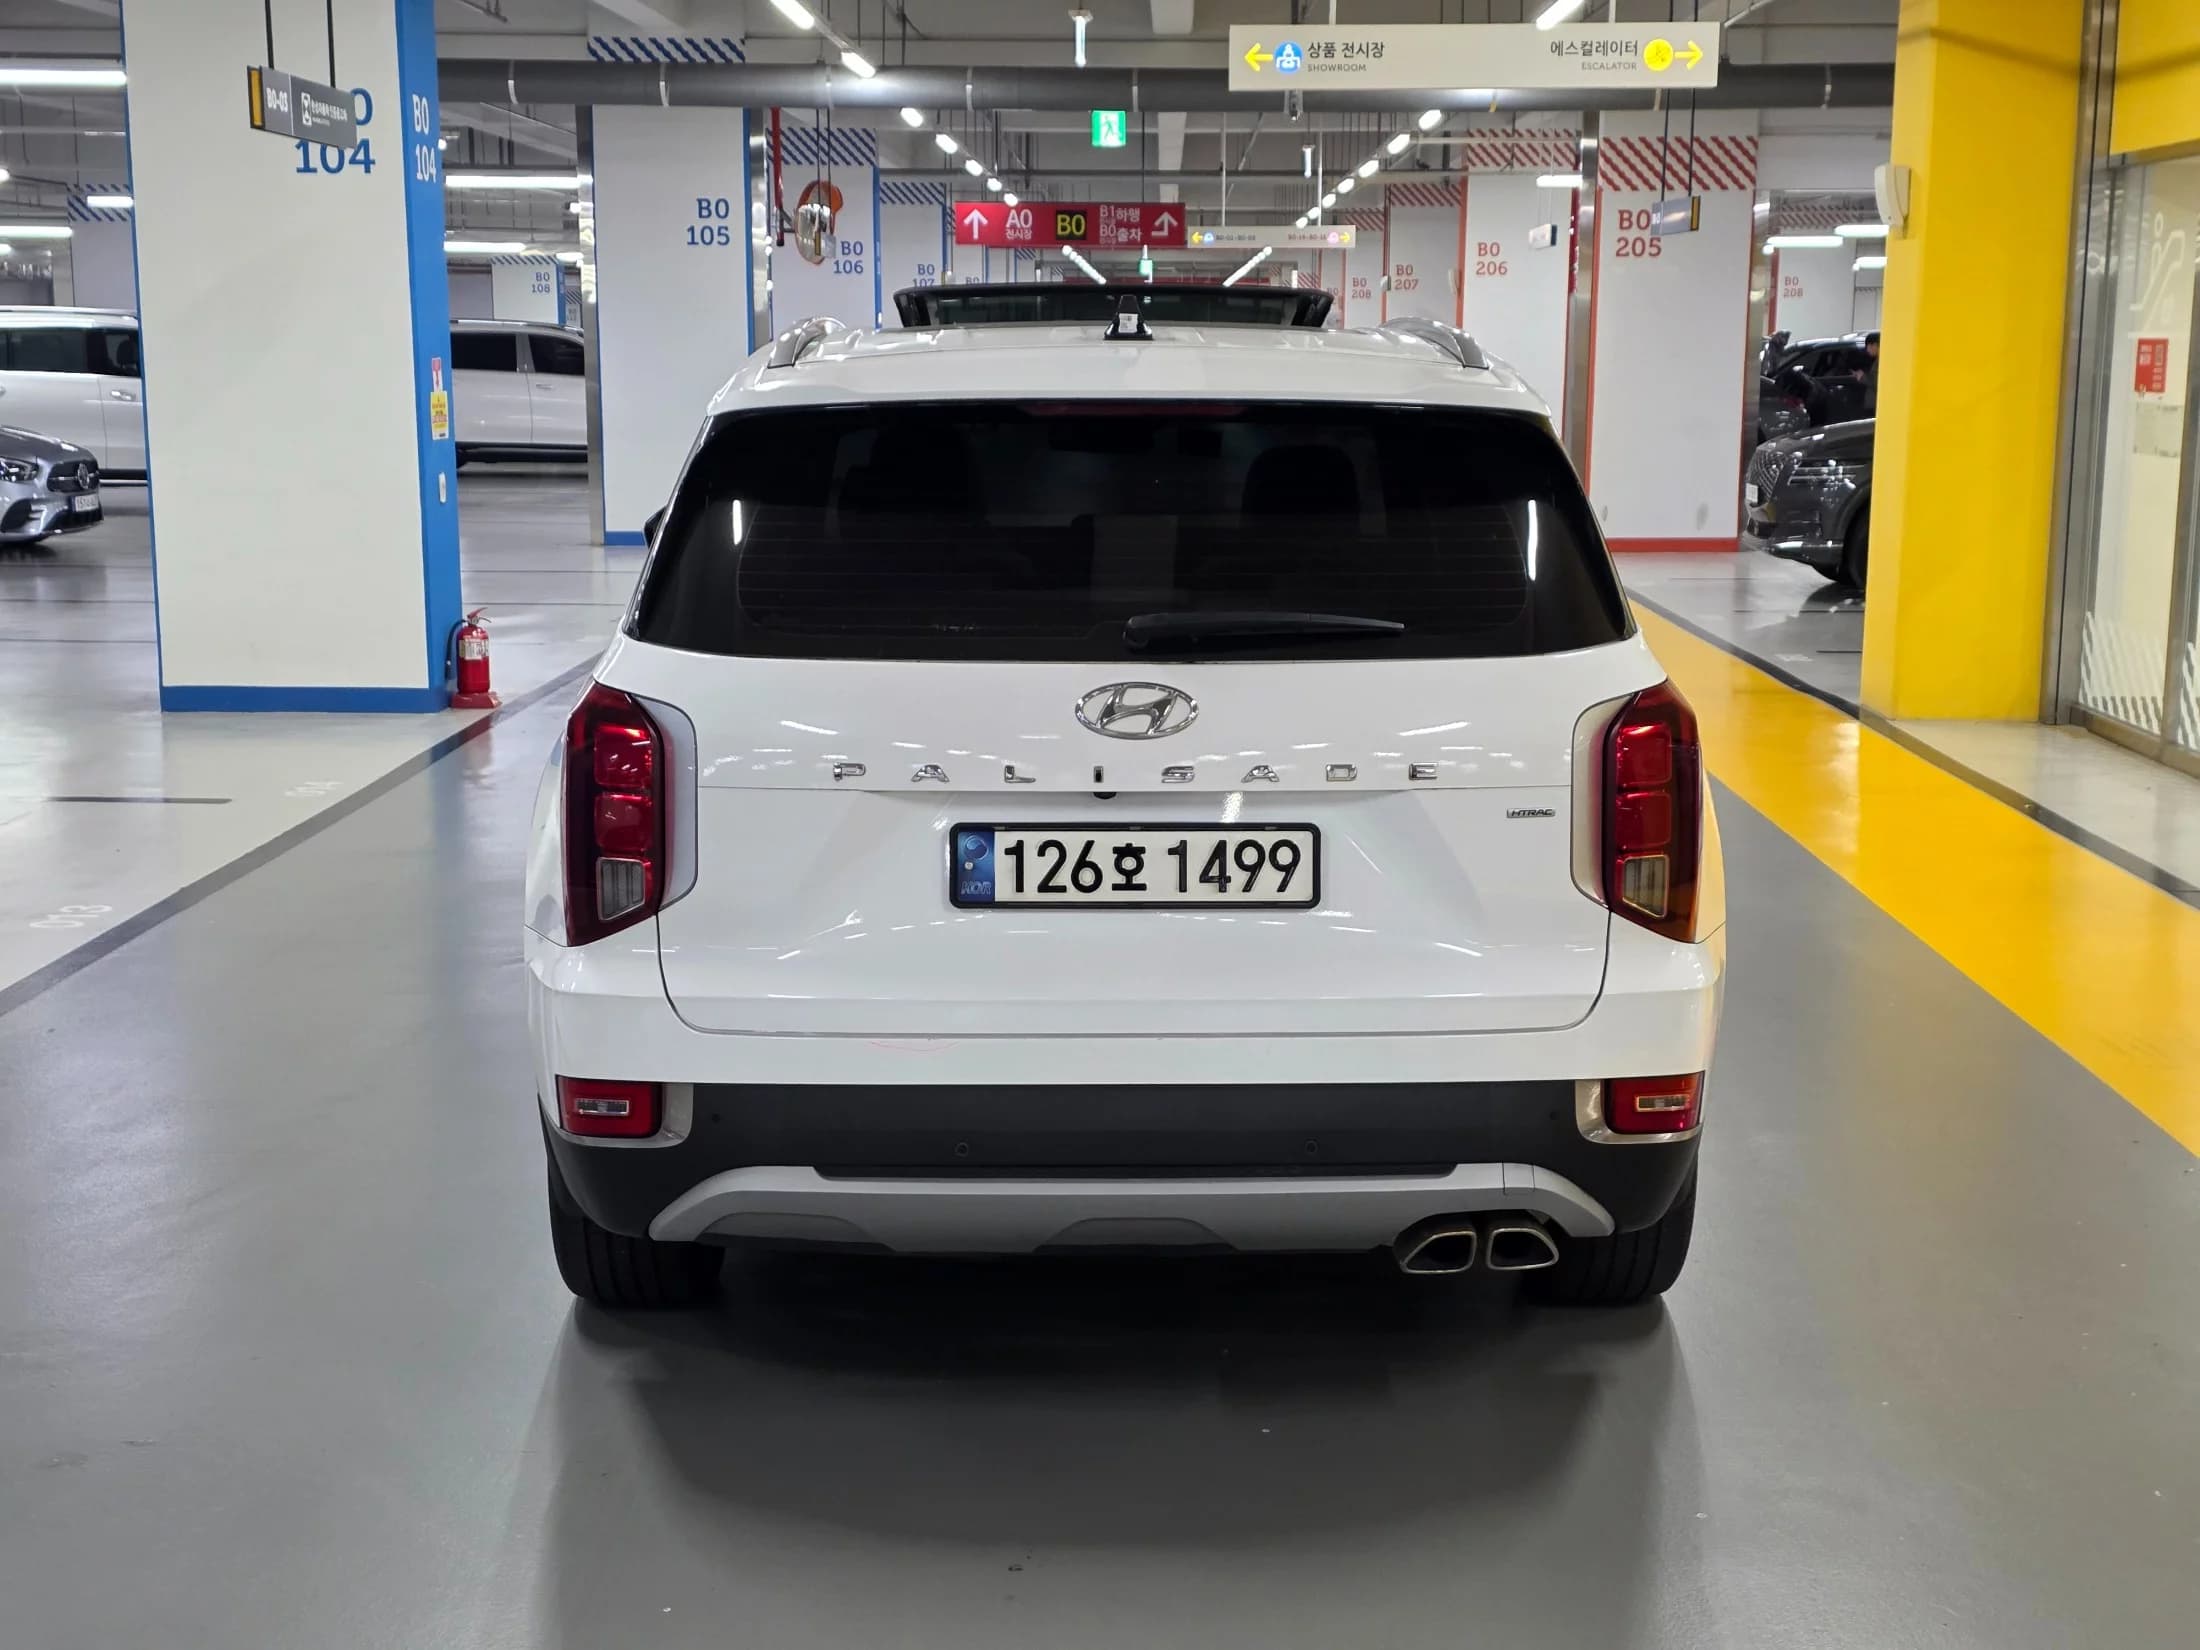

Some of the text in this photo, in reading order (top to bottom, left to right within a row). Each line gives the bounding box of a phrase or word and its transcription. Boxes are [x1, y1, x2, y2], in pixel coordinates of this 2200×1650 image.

[1307, 41, 1385, 59] 상품 전시장
[1550, 40, 1638, 56] 에스컬레이터
[1307, 63, 1367, 72] SHOWROOM
[1581, 62, 1637, 71] ESCALATOR
[266, 87, 288, 113] B0-03
[412, 94, 430, 135] B0
[294, 138, 377, 175] 104
[415, 143, 437, 183] 104
[696, 197, 730, 219] B0
[1005, 208, 1033, 228] A0
[1056, 214, 1086, 236] B0
[1618, 209, 1650, 230] B0
[686, 225, 731, 246] 105
[1005, 228, 1033, 240] 전시장
[840, 241, 864, 256] B0
[1477, 242, 1501, 257] B0
[1615, 237, 1662, 257] 205
[833, 260, 864, 274] 106
[917, 263, 935, 275] B0
[1395, 264, 1414, 276] B0
[1475, 261, 1508, 276] 206
[535, 272, 550, 282] B0
[1352, 277, 1368, 288] B0
[1784, 276, 1800, 286] B0
[531, 284, 551, 293] 108
[1394, 279, 1420, 291] 207
[1351, 289, 1372, 300] 208
[833, 761, 1438, 784] PALISADE
[1511, 808, 1553, 817] HTRAC
[1004, 838, 1302, 894] 126호 1499
[28, 904, 113, 929] 013
